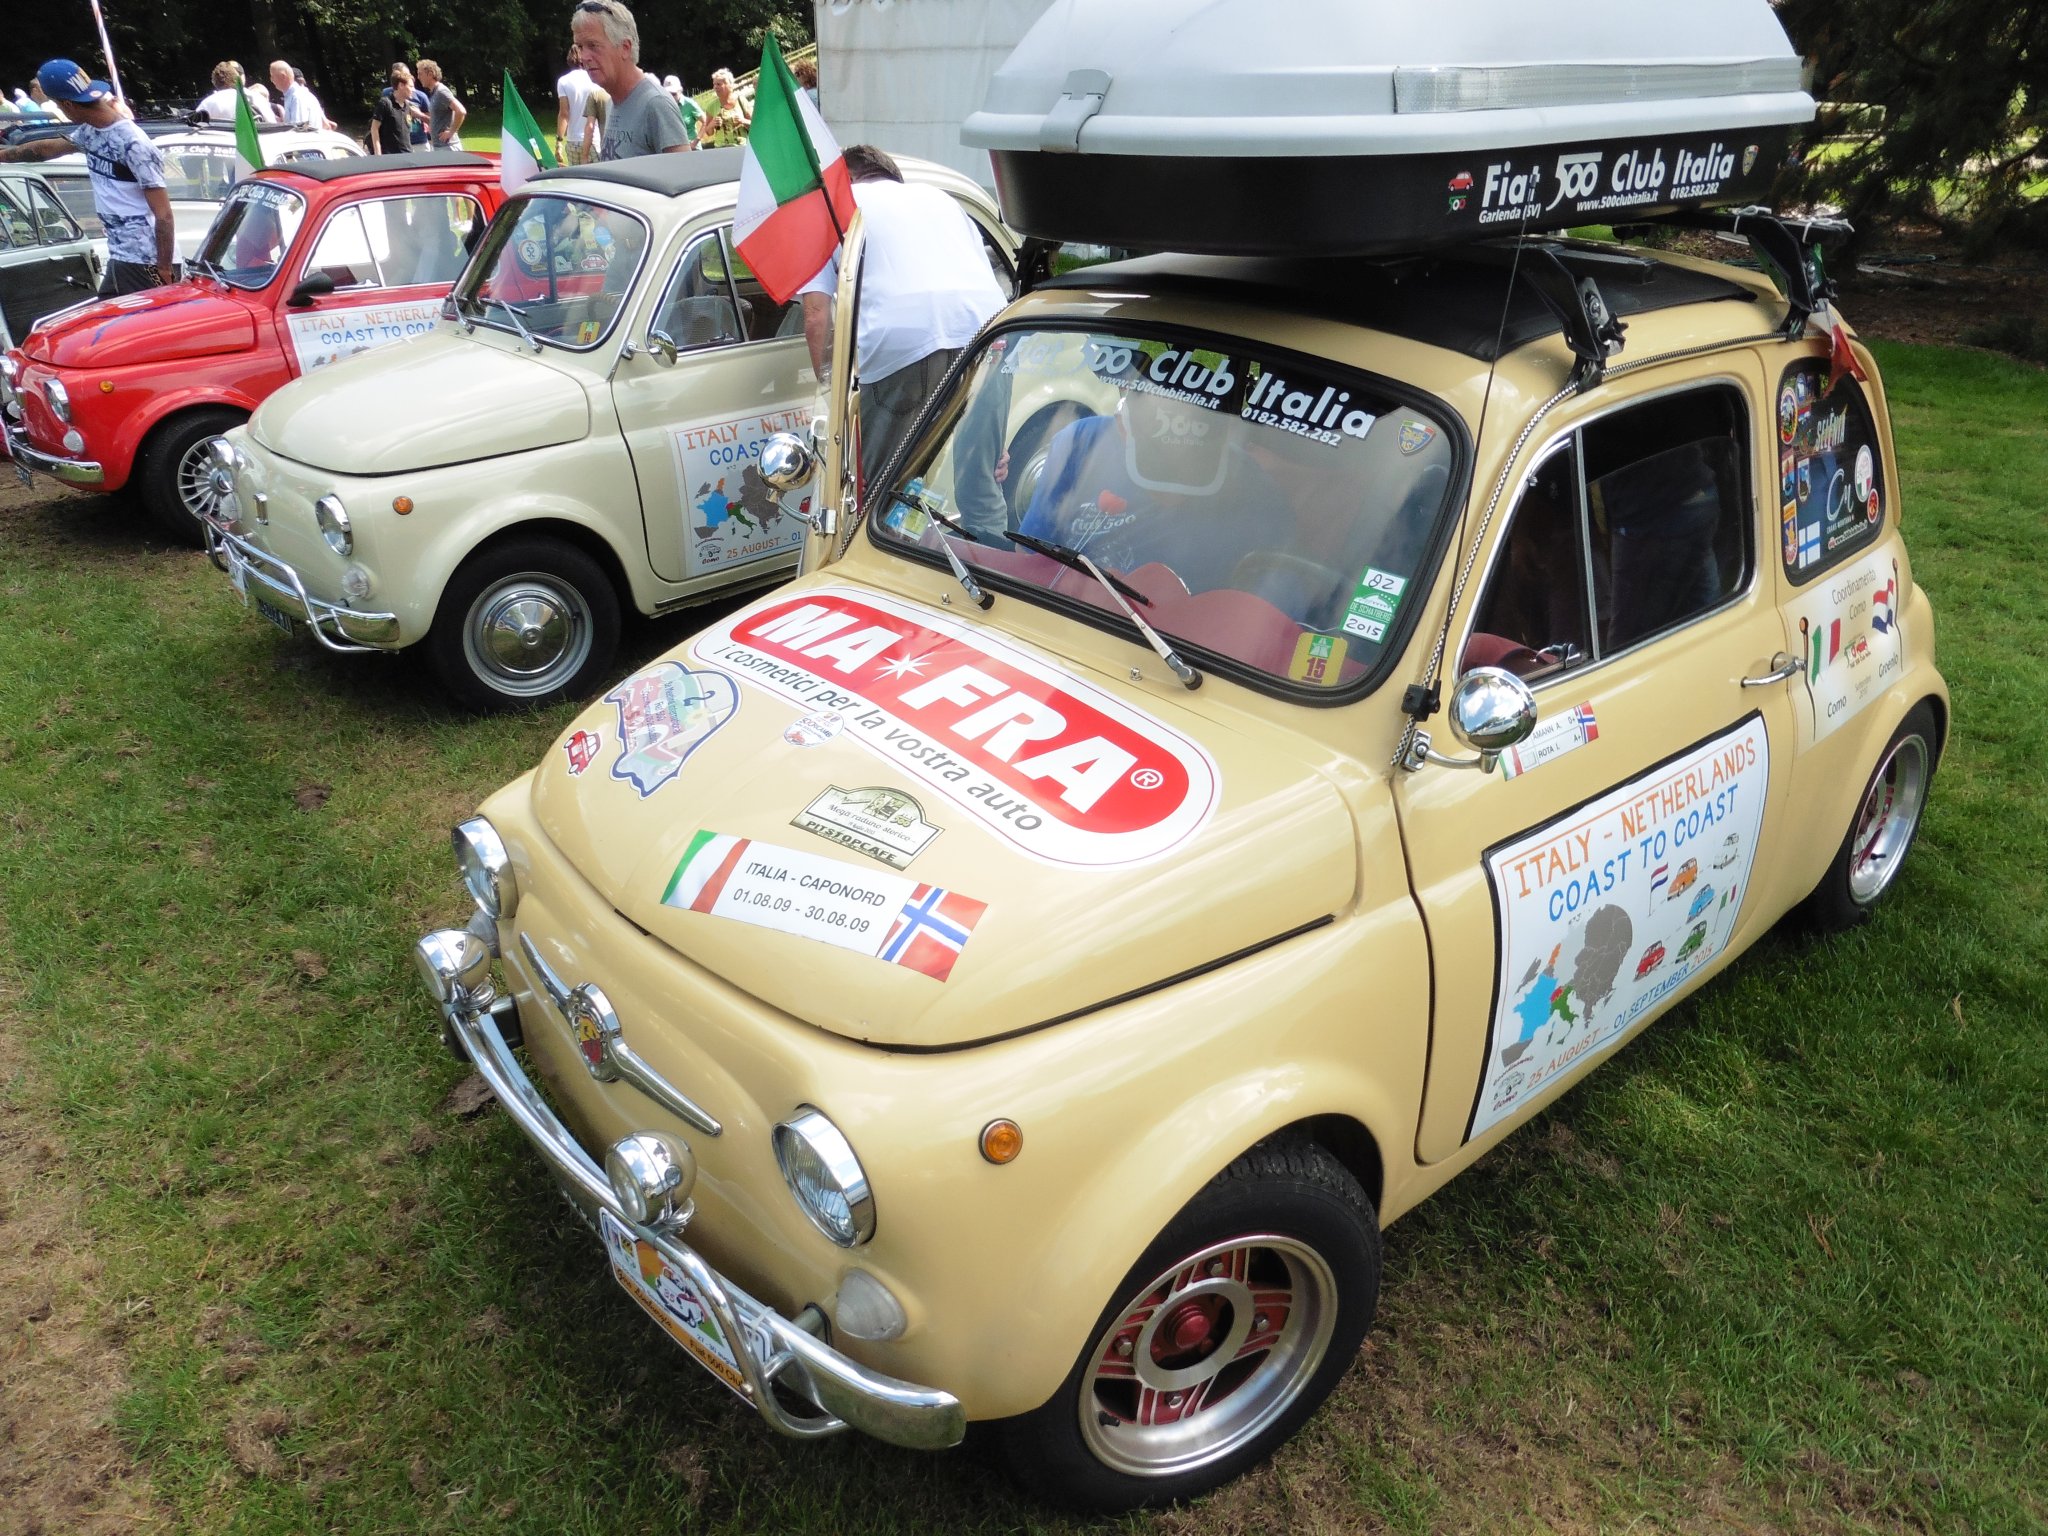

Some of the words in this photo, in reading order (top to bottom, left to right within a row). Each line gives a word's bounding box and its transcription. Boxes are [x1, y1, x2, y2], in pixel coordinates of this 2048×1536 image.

[1481, 160, 1540, 207] Fiat
[1546, 152, 1602, 211] 500
[1611, 148, 1665, 192] Club
[1673, 142, 1734, 185] Italia
[1670, 182, 1719, 200] 0182.582.282
[1479, 206, 1521, 224] Garlenda
[1577, 190, 1658, 212] www.500clubitalia.it
[301, 316, 346, 333] ITALY
[321, 328, 374, 346] COAST
[380, 325, 401, 338] TO
[1099, 375, 1220, 410] www.500clubitalia.it
[1149, 350, 1235, 396] Club
[1247, 372, 1376, 440] Italia
[685, 424, 738, 450] ITALY
[1241, 407, 1342, 447] 0182.582.282
[727, 547, 738, 558] 25
[741, 536, 781, 555] AUGUST
[1832, 568, 1877, 605] Coordinamento
[1346, 618, 1382, 636] 2015
[1849, 600, 1867, 620] Como
[1307, 657, 1327, 678] 15
[1879, 653, 1899, 678] Groenlo
[748, 603, 904, 674] MA
[897, 664, 1138, 814] FRA
[1827, 696, 1847, 718] Como
[713, 644, 736, 655] i
[725, 647, 818, 693] cosmetici
[808, 682, 860, 712] per
[853, 709, 886, 730] la
[884, 727, 970, 782] vostra
[967, 782, 1042, 830] auto
[1532, 726, 1553, 740] AMANN
[1538, 744, 1554, 758] ROTA
[829, 804, 850, 818] Mega
[851, 812, 882, 829] raduno
[883, 827, 911, 842] storico
[1514, 829, 1591, 899] ITALY
[1621, 737, 1756, 842] NETHERLANDS
[805, 820, 898, 862] PITSTOPCAFE
[1550, 849, 1631, 922] COAST
[1640, 830, 1666, 868] TO
[1674, 784, 1738, 848] COAST
[745, 862, 788, 882] ITALIA
[800, 875, 885, 907] CAPONORD
[733, 888, 792, 912] 01.08.09
[804, 906, 870, 933] 30.08.09
[1527, 1071, 1542, 1089] 25
[1545, 1029, 1600, 1075] AUGUST
[1628, 963, 1689, 1018] SEPTEMBER
[1692, 943, 1713, 969] 2015
[690, 1339, 706, 1359] Fiat
[709, 1355, 723, 1373] 500
